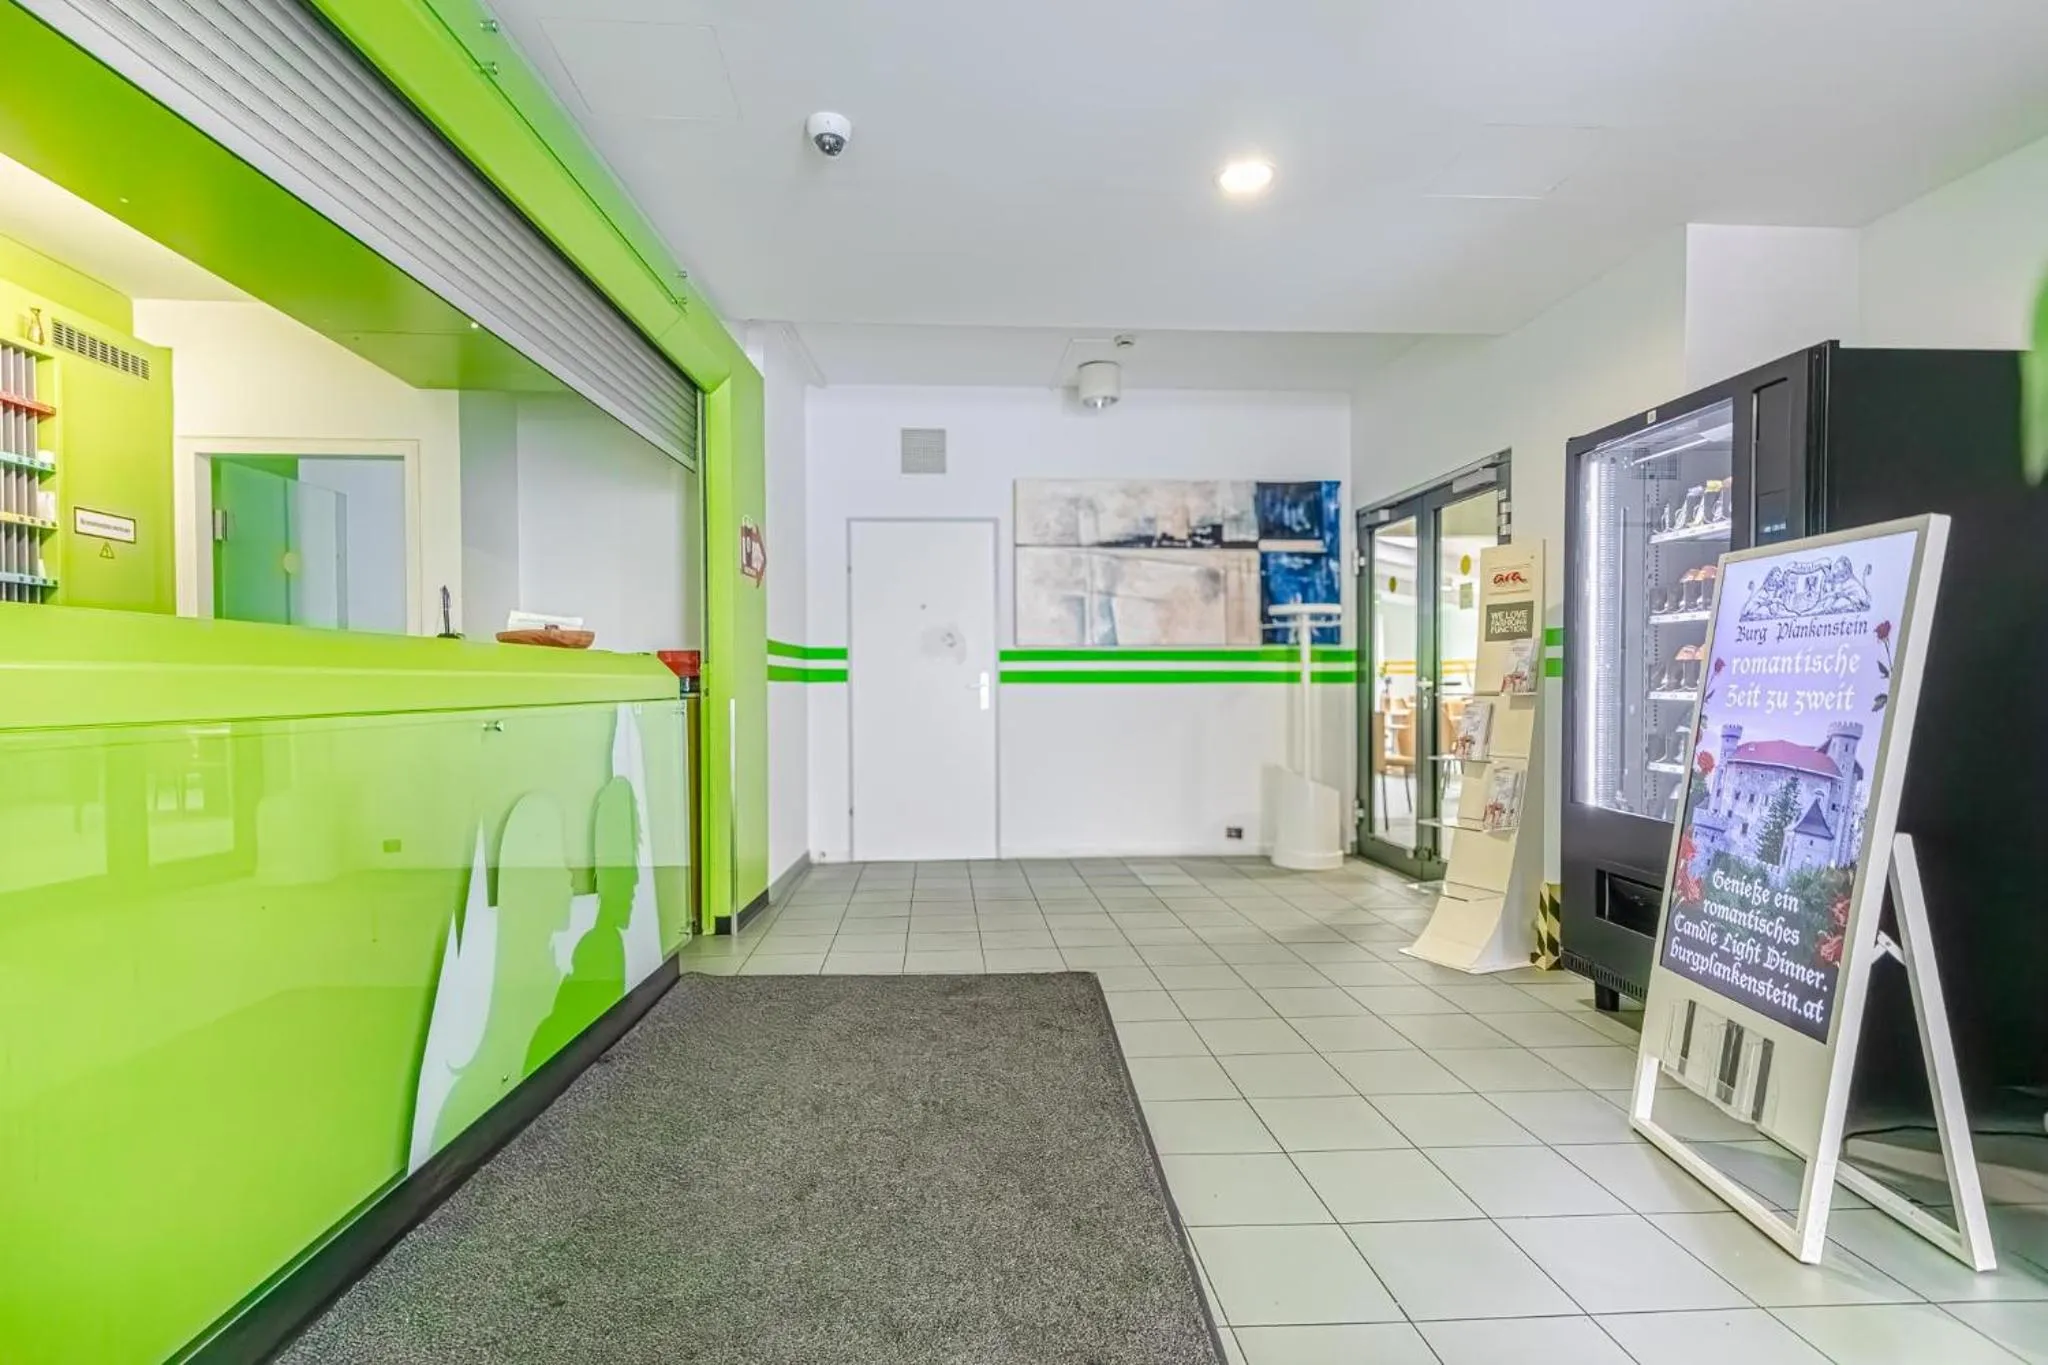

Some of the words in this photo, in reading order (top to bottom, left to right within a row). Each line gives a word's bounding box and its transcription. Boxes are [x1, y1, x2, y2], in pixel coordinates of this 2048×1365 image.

[1490, 610, 1505, 620] WE
[1505, 609, 1528, 619] LOVE
[1735, 624, 1769, 645] Burg
[1776, 616, 1868, 644] Plankenstein
[1731, 643, 1861, 681] romantische
[1725, 681, 1762, 708] Zeit
[1764, 689, 1788, 715] zu
[1793, 682, 1855, 716] zweit
[1712, 868, 1771, 906] Genieße
[1774, 888, 1800, 913] ein
[1703, 898, 1800, 946] romantisches
[1673, 911, 1719, 946] Candle
[1719, 931, 1762, 965] Light
[1763, 945, 1828, 993] Dinner.
[1670, 936, 1825, 1024] burgplankenstein.at
